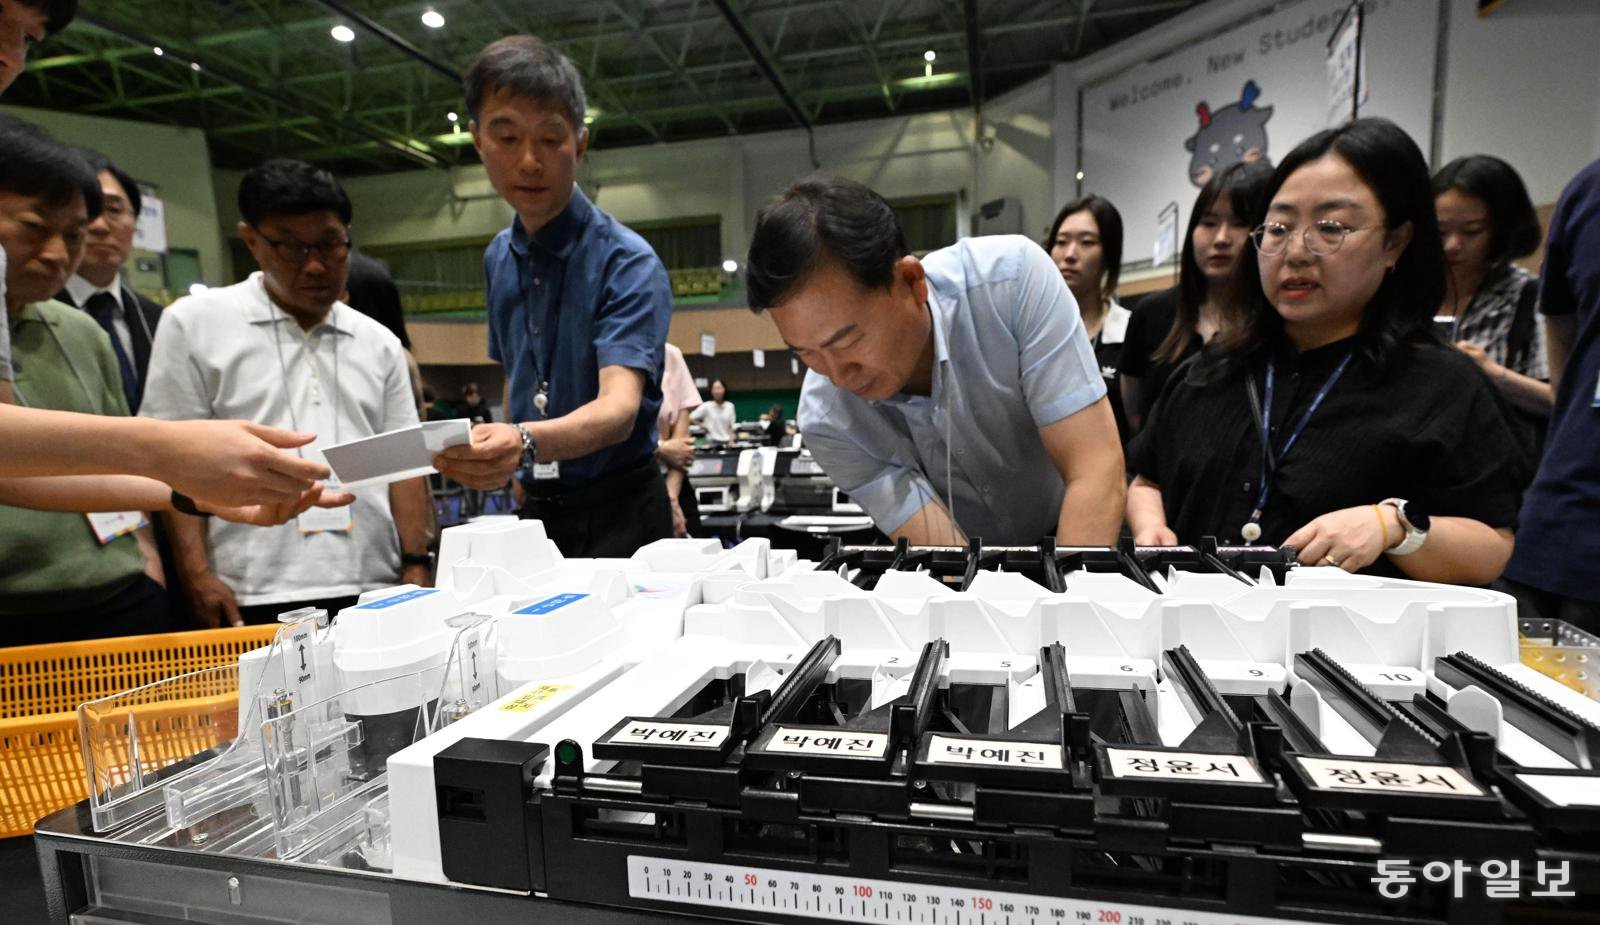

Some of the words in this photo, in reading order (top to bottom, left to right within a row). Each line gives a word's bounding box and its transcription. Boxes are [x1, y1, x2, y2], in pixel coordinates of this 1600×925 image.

[1206, 48, 1247, 74] New
[1000, 660, 1012, 668] 5
[1379, 672, 1413, 682] 10
[631, 727, 717, 743] 박예진
[783, 734, 874, 752] 박예진
[946, 745, 1045, 764] 박예진
[1127, 757, 1240, 777] 정윤서
[1325, 767, 1456, 790] 정윤서
[643, 866, 649, 875] 0
[663, 868, 672, 877] 10
[683, 870, 692, 879] 20
[704, 872, 713, 881] 30
[725, 875, 734, 884] 40
[745, 874, 757, 886] 50
[768, 879, 778, 888] 60
[790, 882, 800, 891] 70
[812, 884, 822, 893] 80
[835, 887, 845, 896] 90
[853, 885, 873, 898] 100
[879, 891, 893, 900] 110
[903, 893, 917, 903] 120
[927, 895, 941, 905] 130
[951, 898, 965, 908] 140
[972, 897, 993, 911] 150
[1000, 903, 1015, 913] 160
[1025, 905, 1040, 915] 170
[1050, 908, 1065, 918] 180
[1076, 911, 1091, 921] 190
[1098, 910, 1121, 924] 200
